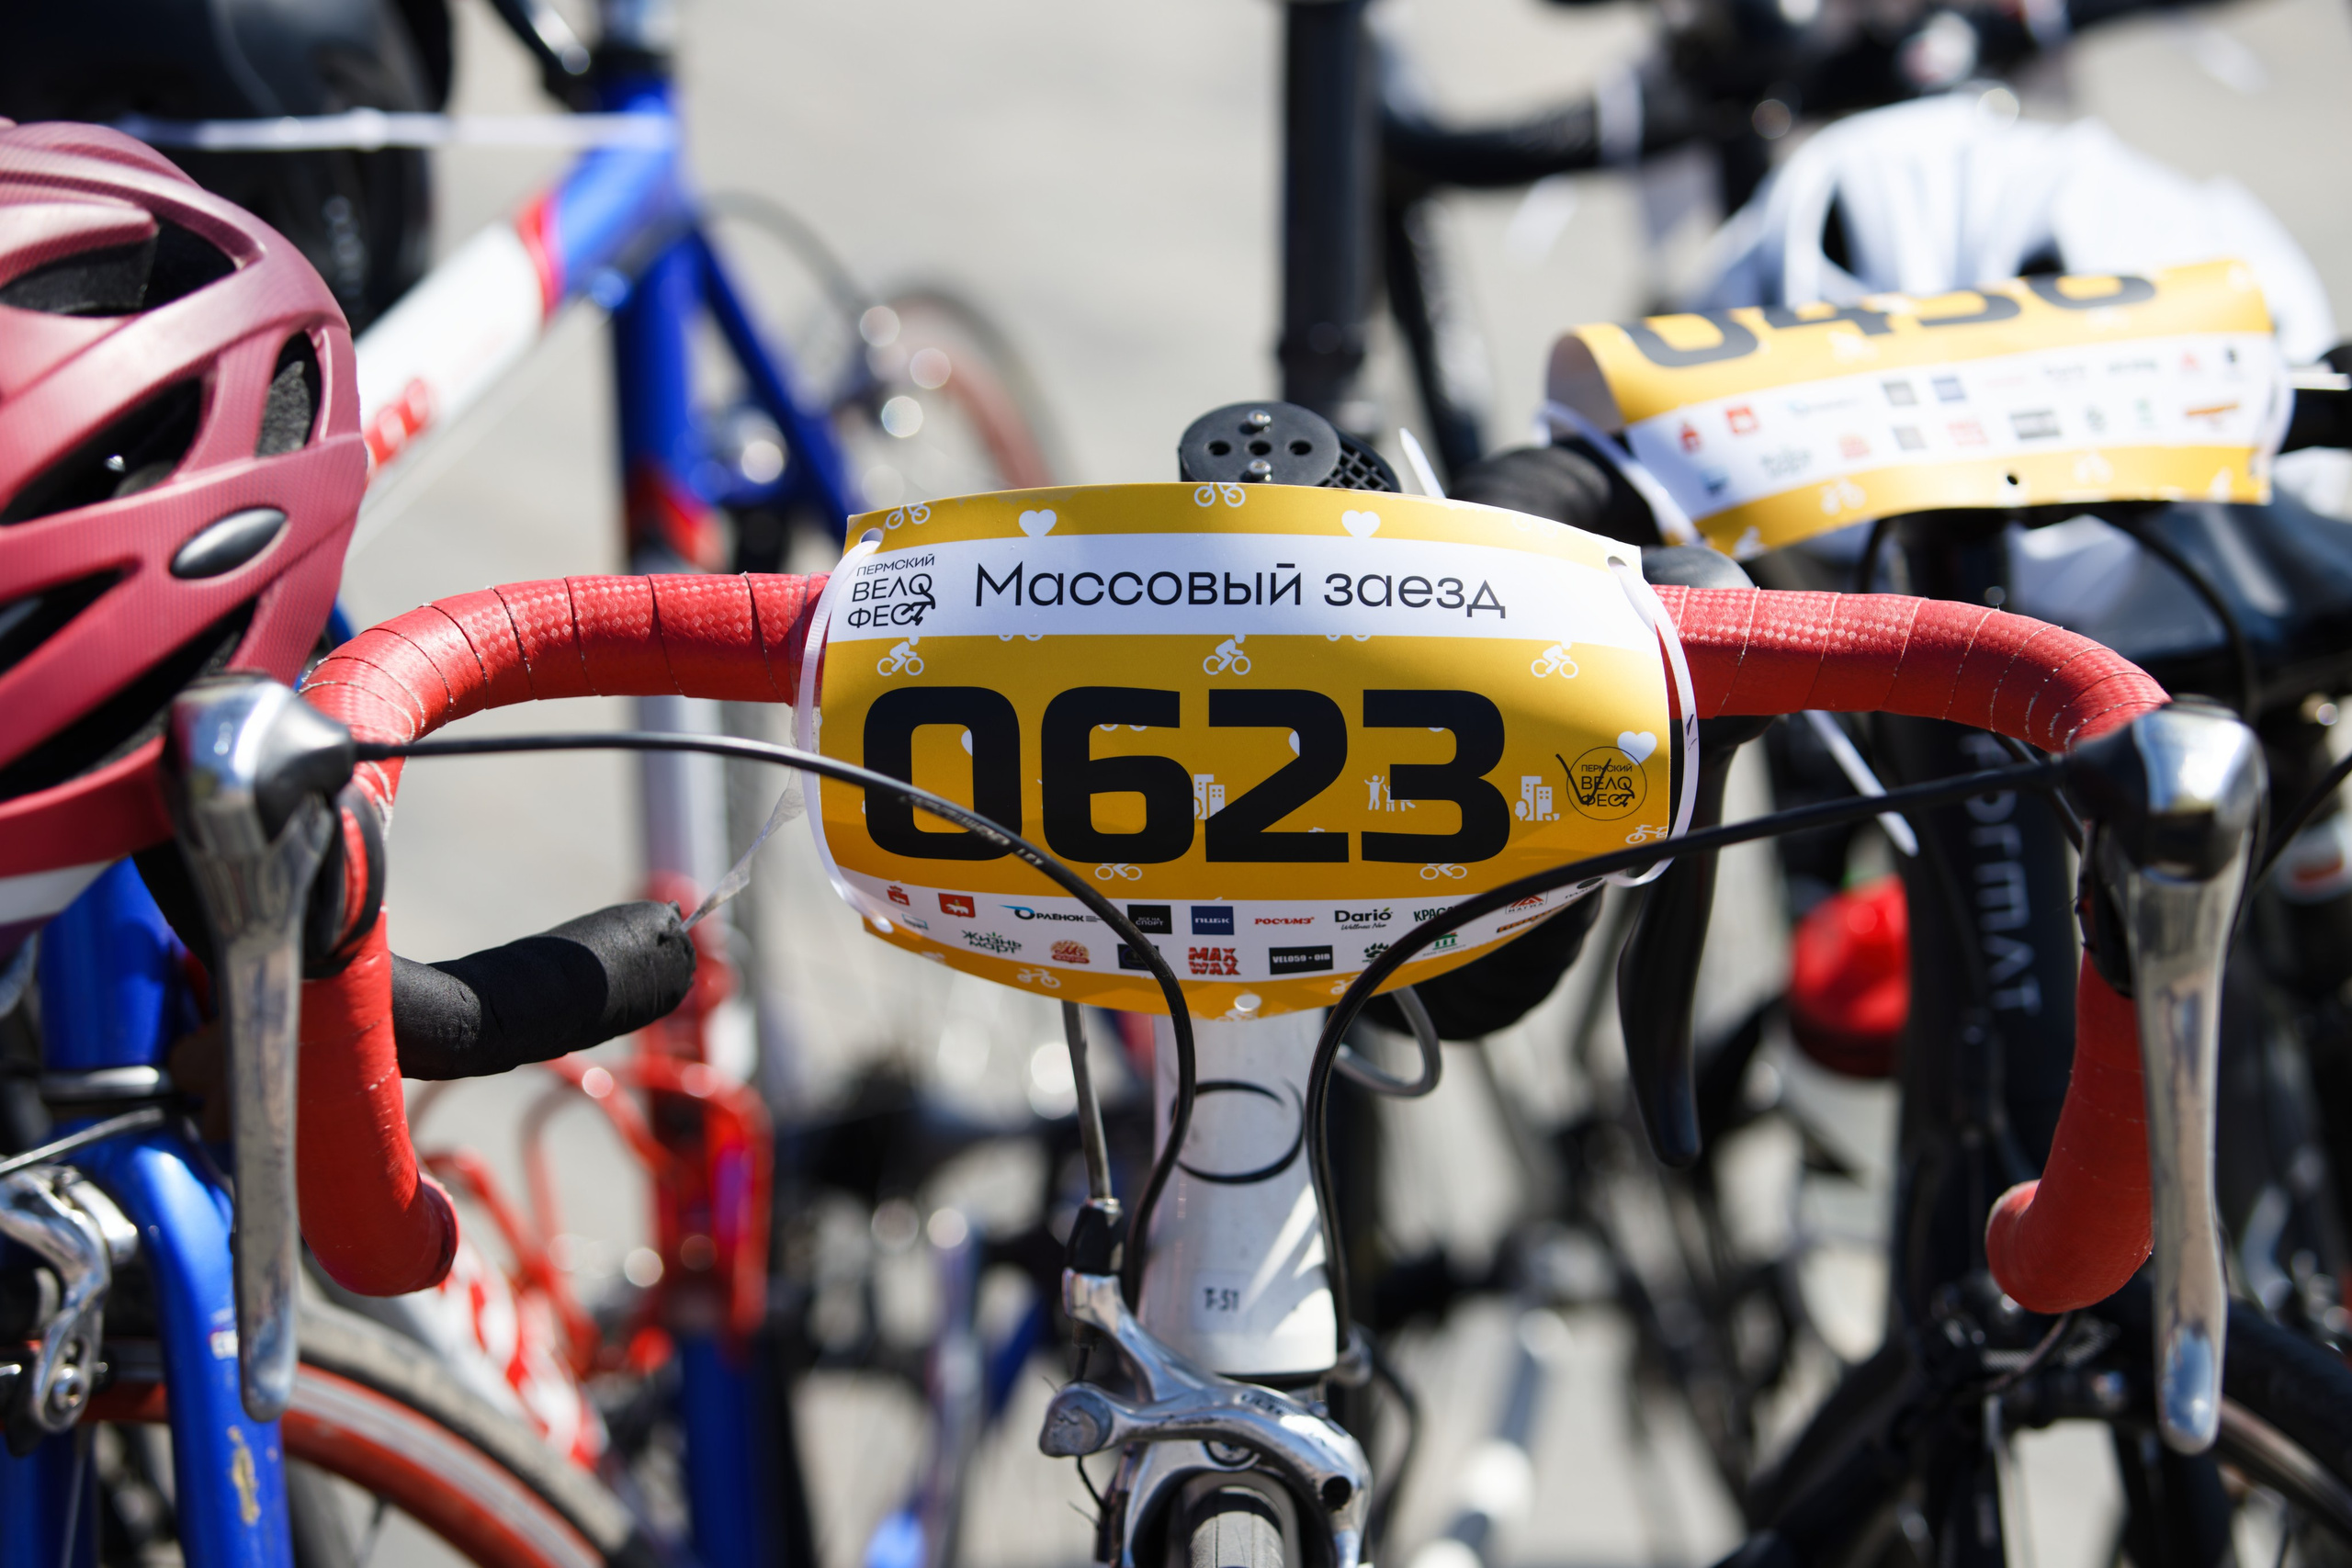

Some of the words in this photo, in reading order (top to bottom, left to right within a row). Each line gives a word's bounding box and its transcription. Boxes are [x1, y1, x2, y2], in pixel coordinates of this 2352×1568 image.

[855, 553, 935, 577] ПЕРМСКИЙ
[976, 560, 1302, 607] Массовый
[1323, 572, 1507, 619] заезд
[863, 684, 1511, 865] 0623
[1580, 762, 1633, 773] ПЕРМСКИЙ
[1188, 947, 1239, 963] MAX
[1188, 961, 1241, 976] WAX
